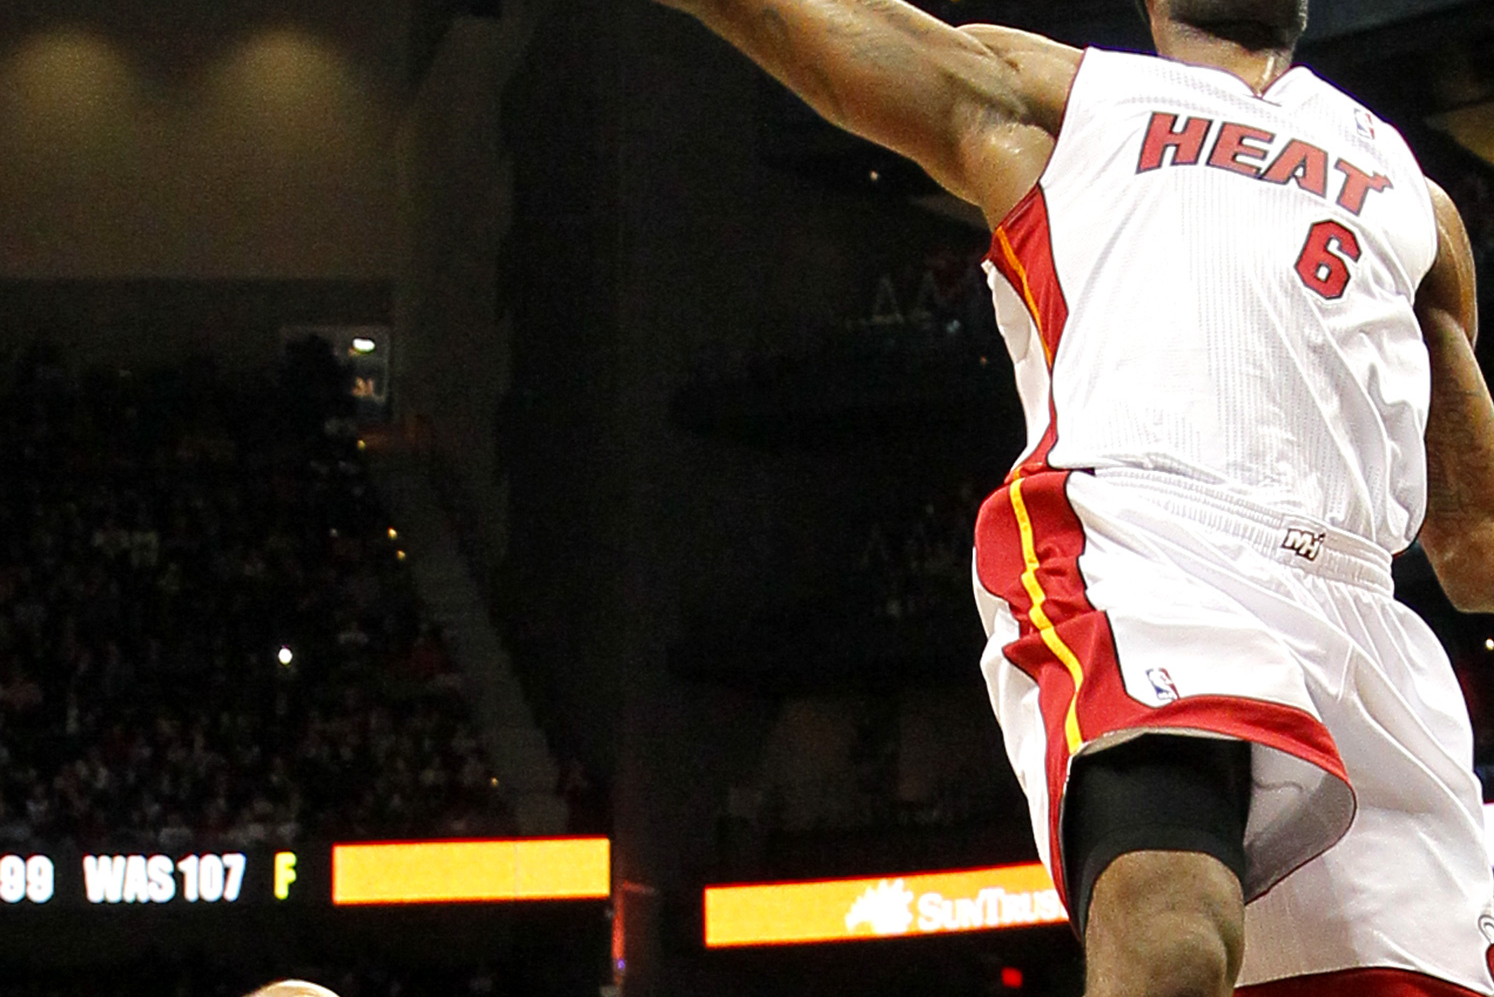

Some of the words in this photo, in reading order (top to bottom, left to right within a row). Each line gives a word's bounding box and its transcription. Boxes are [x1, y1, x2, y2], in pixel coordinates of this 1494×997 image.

[1135, 111, 1394, 216] HEAT
[1294, 219, 1362, 300] 6
[0, 855, 54, 903] 99
[82, 855, 176, 903] WAS
[177, 853, 247, 902] 107
[274, 851, 297, 900] F
